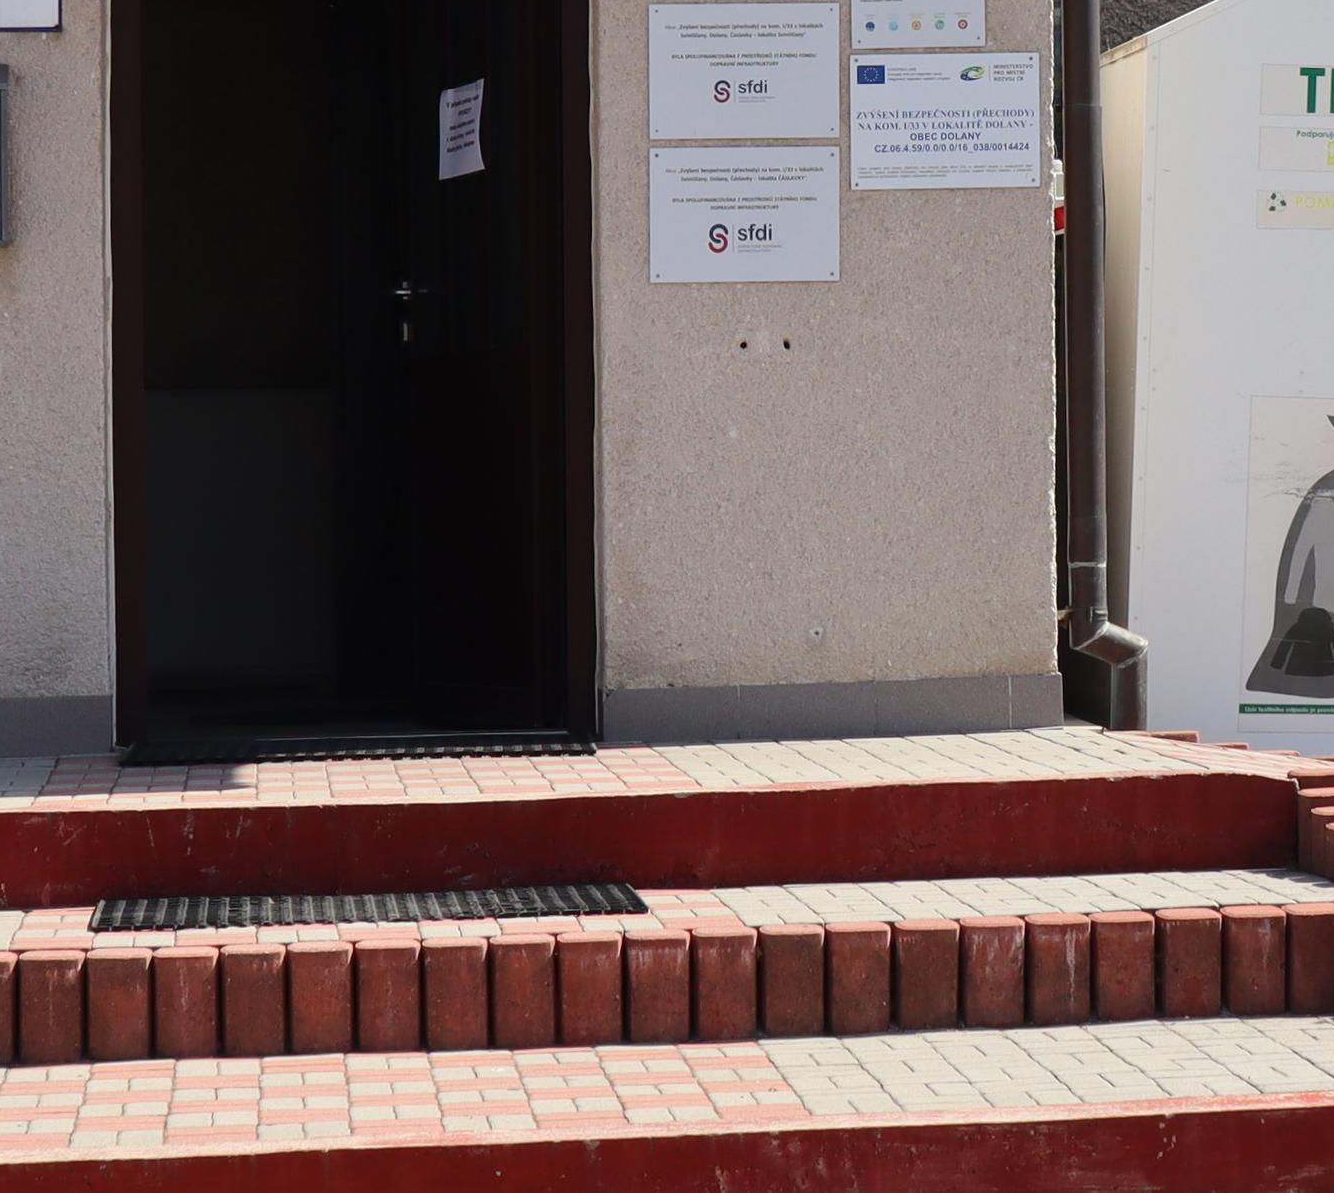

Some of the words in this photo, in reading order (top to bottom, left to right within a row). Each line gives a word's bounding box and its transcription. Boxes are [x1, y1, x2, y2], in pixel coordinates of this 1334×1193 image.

[738, 79, 768, 94] sfdi
[855, 109, 899, 120] ZVÝŠENÍ
[902, 108, 971, 119] BEZPEČNOSTI
[972, 107, 1035, 120] (PŘECHODY)
[858, 122, 873, 131] NA
[874, 122, 901, 131] KOM.
[921, 121, 929, 130] V
[931, 120, 984, 130] LOKALITĚ
[985, 119, 1028, 129] DOLANY
[909, 132, 938, 141] OBEC
[940, 132, 982, 141] DOLANY
[874, 142, 1030, 153] CZ.06.4.59/0.0/0.0/16_038/0014424
[737, 223, 773, 241] sfdi
